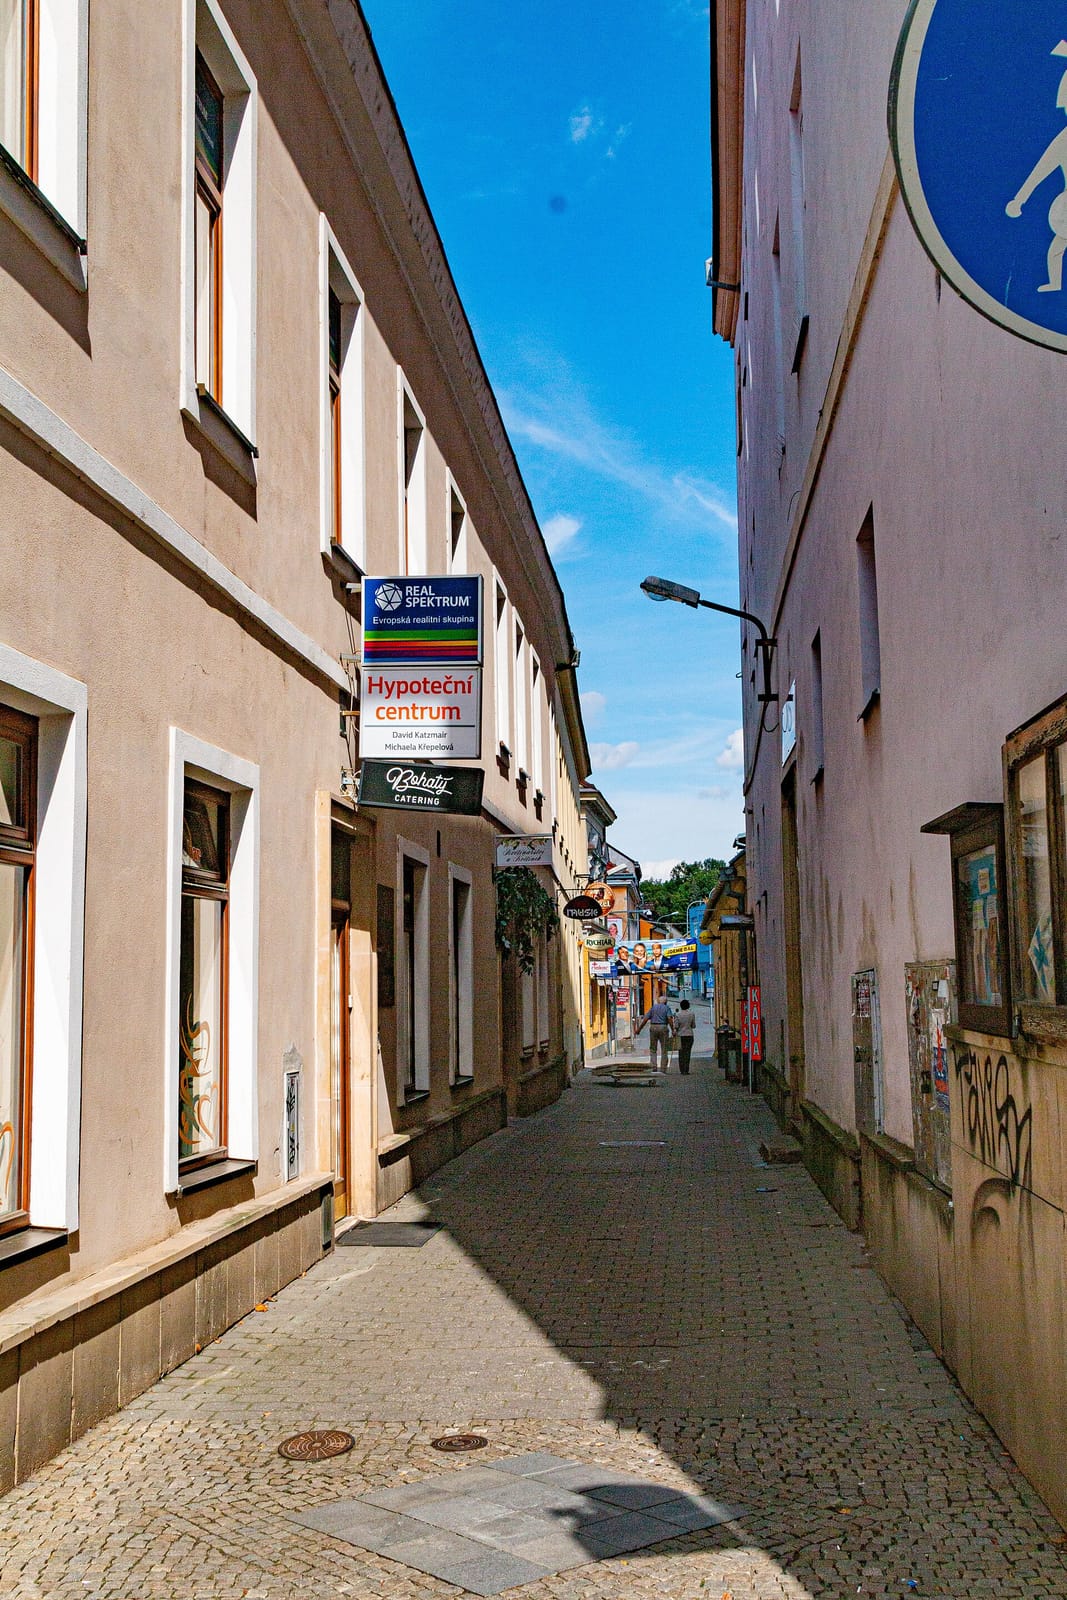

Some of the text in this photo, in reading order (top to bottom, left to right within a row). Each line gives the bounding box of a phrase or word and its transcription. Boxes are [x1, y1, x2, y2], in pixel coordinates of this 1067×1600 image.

[405, 585, 435, 597] REAL
[405, 596, 470, 608] SPEKTRUM
[372, 614, 474, 626] Evropská realitní skupina
[367, 675, 474, 700] Hypoteční
[375, 703, 461, 720] centrum
[392, 731, 448, 739] David Katzmair
[384, 743, 454, 752] Michaela Křepelová
[394, 794, 440, 806] CATERING
[751, 988, 760, 1056] KÁVA
